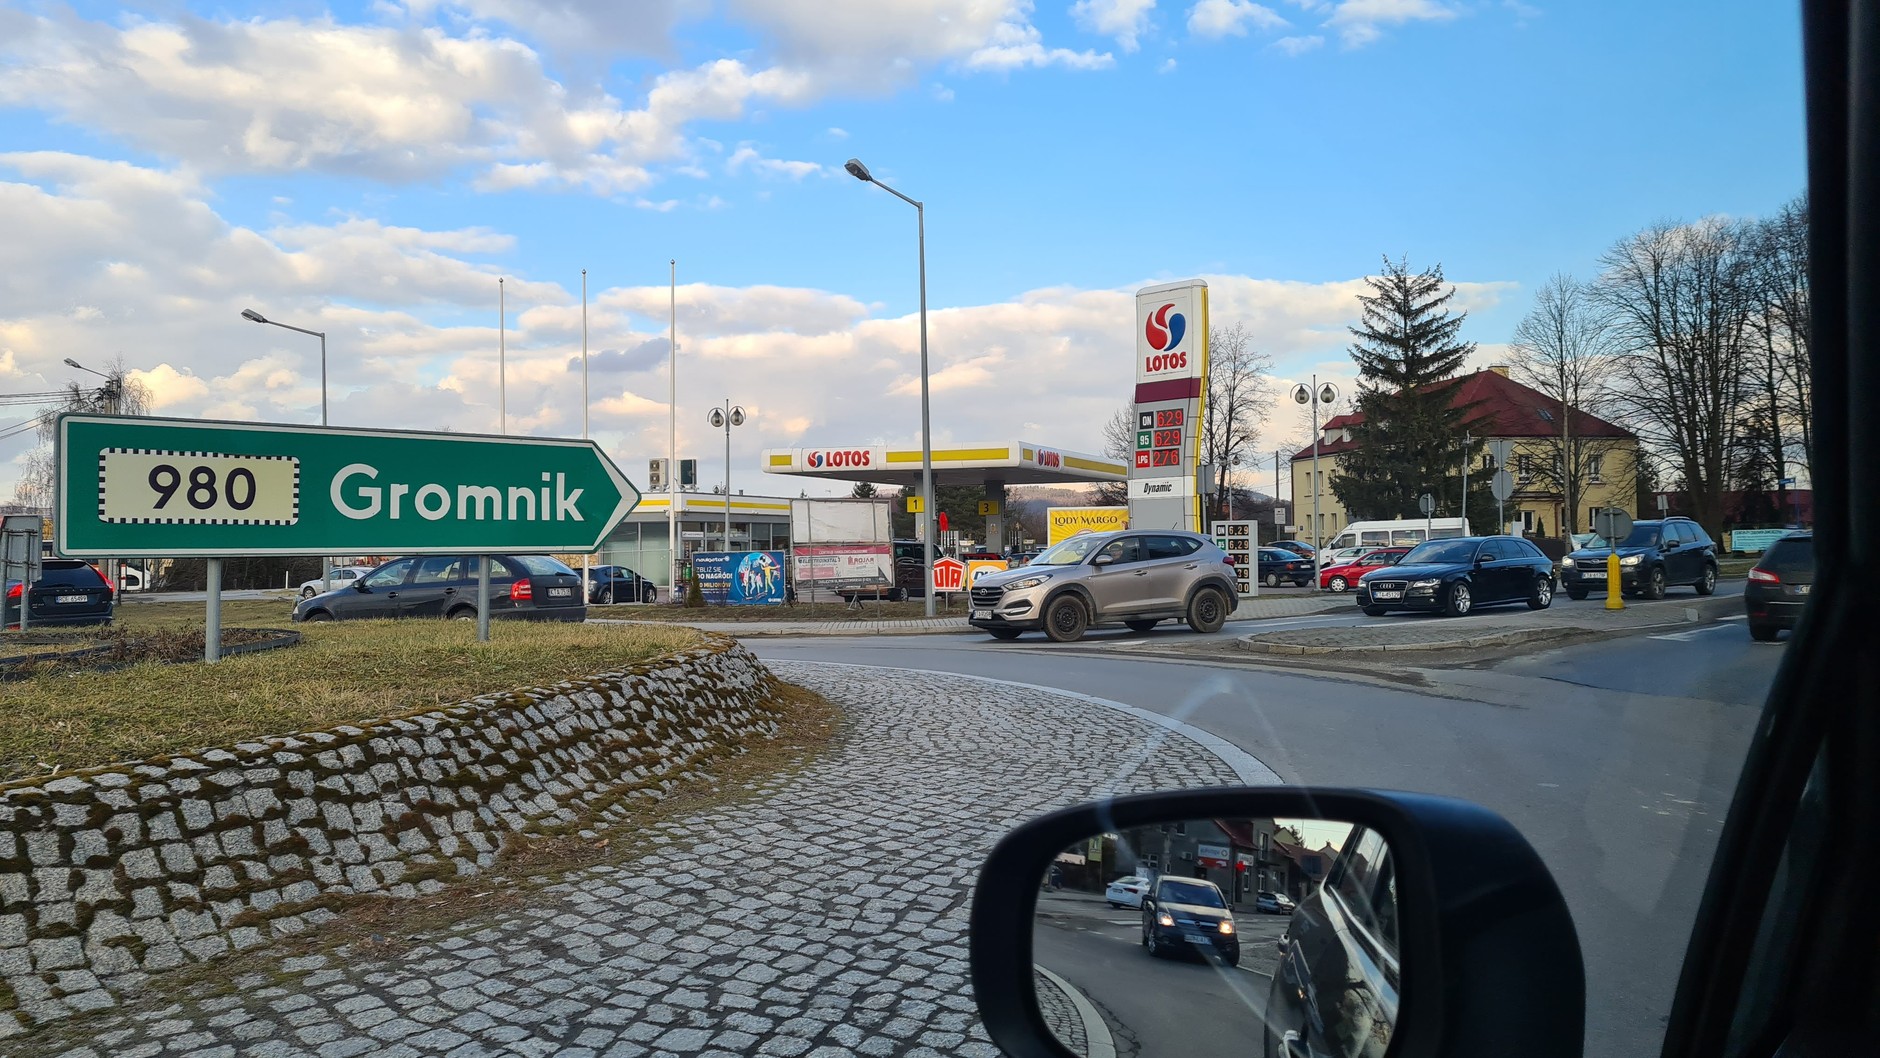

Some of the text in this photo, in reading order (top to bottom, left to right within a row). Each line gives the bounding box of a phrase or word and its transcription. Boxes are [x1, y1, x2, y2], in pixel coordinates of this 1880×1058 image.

[1146, 352, 1187, 372] LOTOS
[1142, 410, 1183, 427] ON 6.29
[1140, 430, 1180, 446] 95 6.29
[826, 450, 870, 467] LOTOS
[1043, 450, 1060, 468] LOTOS
[1137, 450, 1178, 466] LPG 2.76
[148, 464, 256, 510] 980
[330, 463, 585, 521] Gromnik
[1143, 482, 1172, 494] Dynamic
[913, 499, 918, 510] 1
[984, 502, 990, 513] 3
[1055, 516, 1118, 526] LODY MARGO
[1217, 526, 1249, 535] ON 6.29
[1229, 540, 1249, 550] 6.29
[933, 560, 964, 588] UTA
[1237, 568, 1249, 578] 39
[1237, 583, 1249, 592] 00
